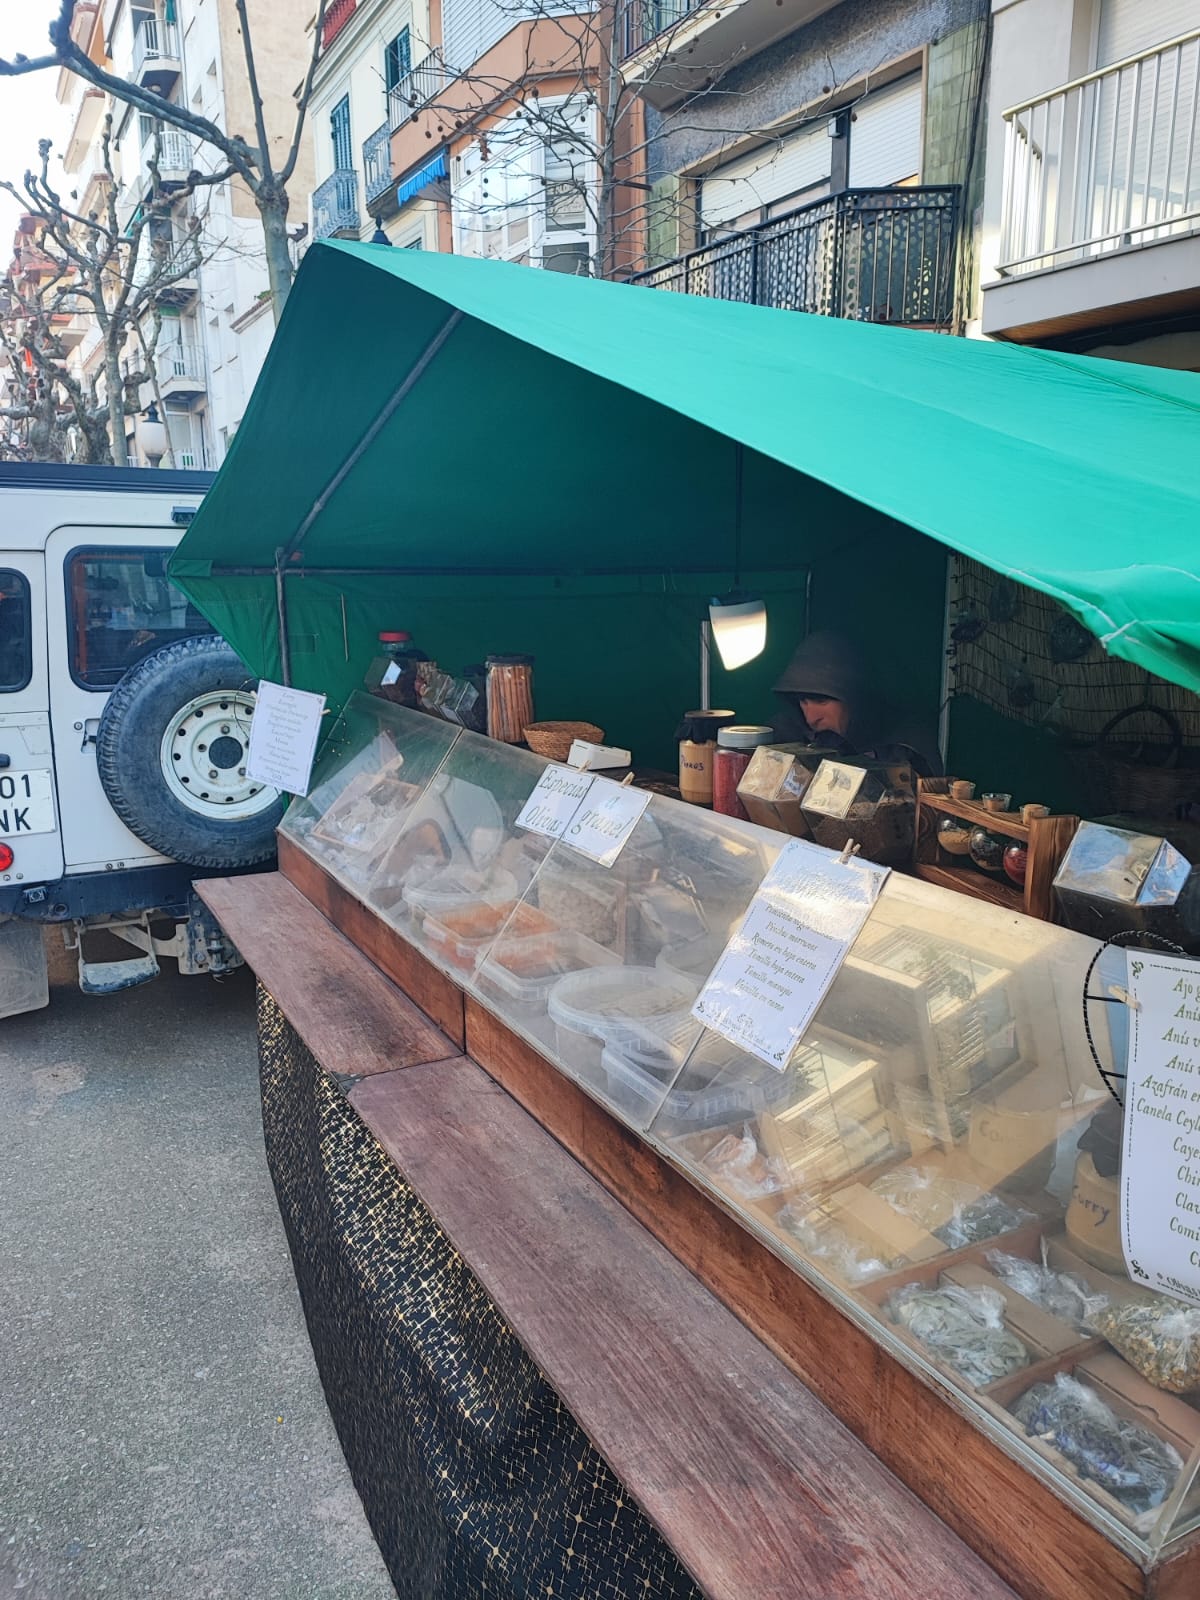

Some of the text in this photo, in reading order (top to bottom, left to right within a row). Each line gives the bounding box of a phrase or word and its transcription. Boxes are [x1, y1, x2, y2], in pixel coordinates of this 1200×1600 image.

[570, 809, 635, 838] granel
[1172, 977, 1193, 1000] Ajo
[1161, 1027, 1190, 1045] Anís
[1164, 1054, 1195, 1073] Anís
[1140, 1074, 1188, 1099] Azafrán
[1137, 1098, 1200, 1134] Canela Ceyl
[1173, 1136, 1200, 1162] Caye
